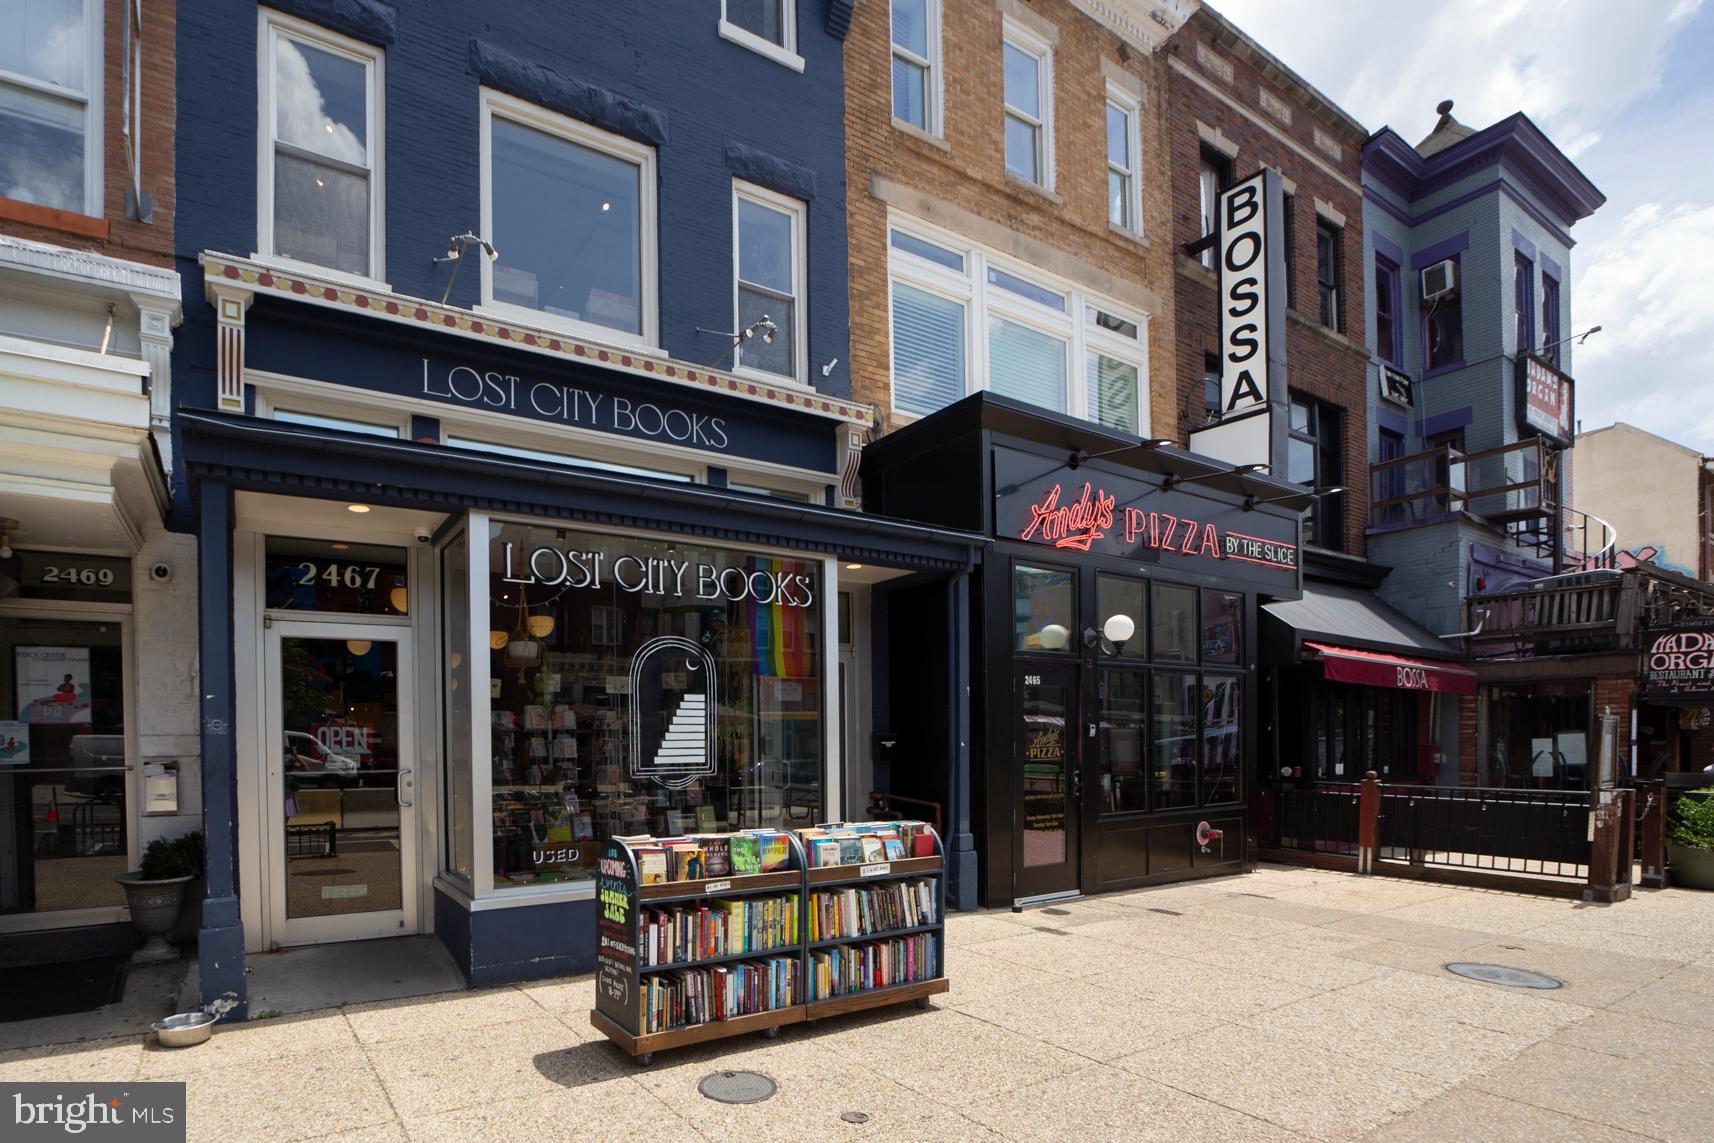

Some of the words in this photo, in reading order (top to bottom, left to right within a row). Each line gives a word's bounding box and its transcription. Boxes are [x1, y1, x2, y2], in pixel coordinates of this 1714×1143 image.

[1225, 185, 1264, 411] BOSSA
[422, 358, 520, 409] LOST
[531, 382, 604, 424] CITY
[613, 397, 728, 448] BOOKS
[1021, 481, 1115, 550] Andy's
[1125, 508, 1220, 558] PIZZA
[1226, 536, 1239, 554] BY
[1242, 540, 1263, 558] THE
[1264, 544, 1294, 565] SLICE
[43, 566, 114, 586] 2469
[297, 562, 381, 589] 2467
[502, 542, 604, 589] LOST
[613, 555, 688, 597] CITY
[696, 563, 813, 607] BOOKS
[1650, 651, 1714, 670] ORG
[1024, 675, 1041, 685] 2465
[1396, 666, 1429, 689] BOSSA
[1649, 669, 1706, 680] RESTAURANT
[316, 726, 369, 752] OPEN
[1030, 747, 1061, 759] PIZZA
[533, 848, 579, 864] USED
[600, 888, 629, 910] SUMMER
[604, 904, 626, 924] SALE
